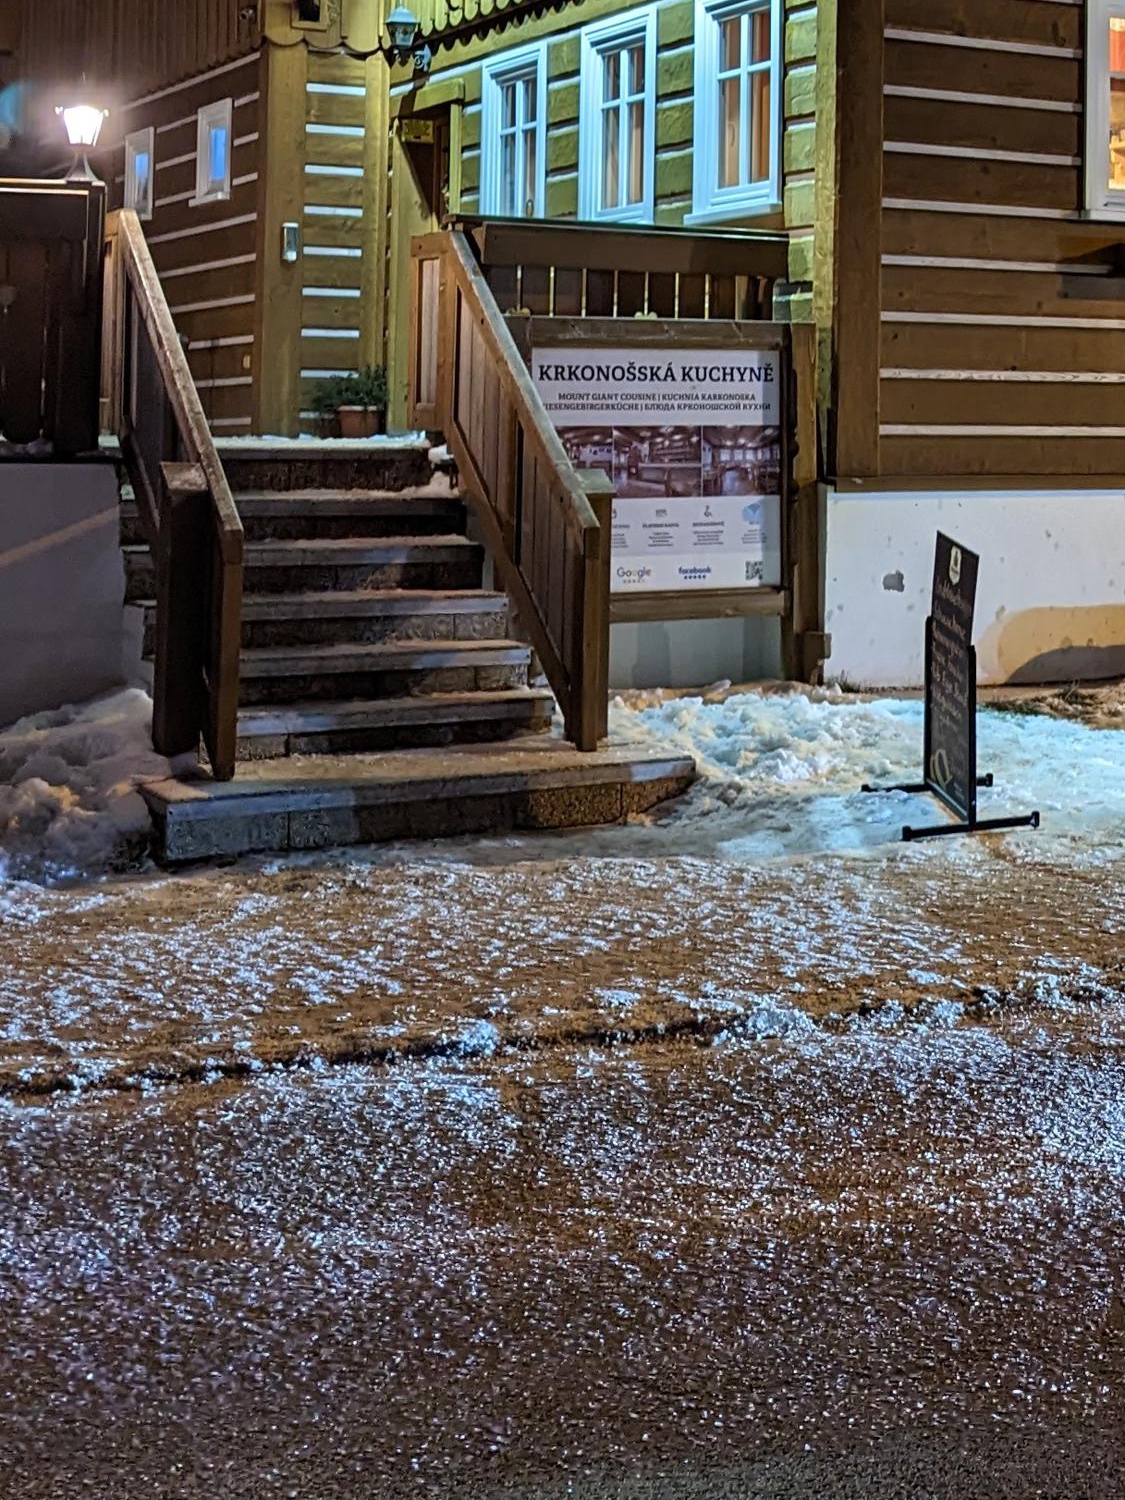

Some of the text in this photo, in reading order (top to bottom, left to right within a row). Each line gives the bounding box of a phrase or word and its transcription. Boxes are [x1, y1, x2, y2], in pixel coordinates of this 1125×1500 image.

[538, 361, 774, 382] KRKONOŠSKÁ KUCHYNĚ
[558, 392, 590, 401] MOUNT
[591, 392, 618, 401] GIANT
[662, 392, 699, 401] KUCHNIA
[678, 566, 712, 576] facebook
